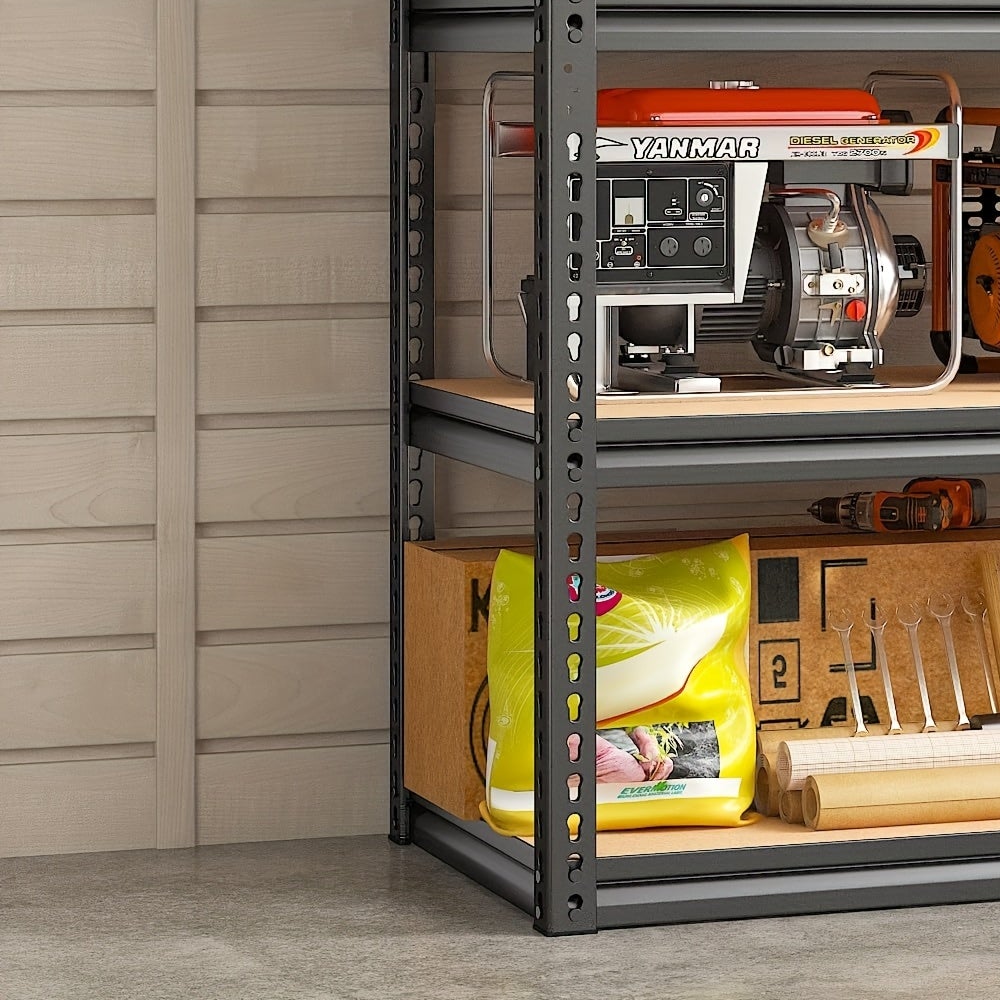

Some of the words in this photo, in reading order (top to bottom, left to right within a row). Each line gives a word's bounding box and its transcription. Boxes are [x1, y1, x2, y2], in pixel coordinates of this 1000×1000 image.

[630, 137, 761, 160] YANMAR
[789, 136, 838, 146] DIESEL
[840, 135, 916, 145] GENERATOR
